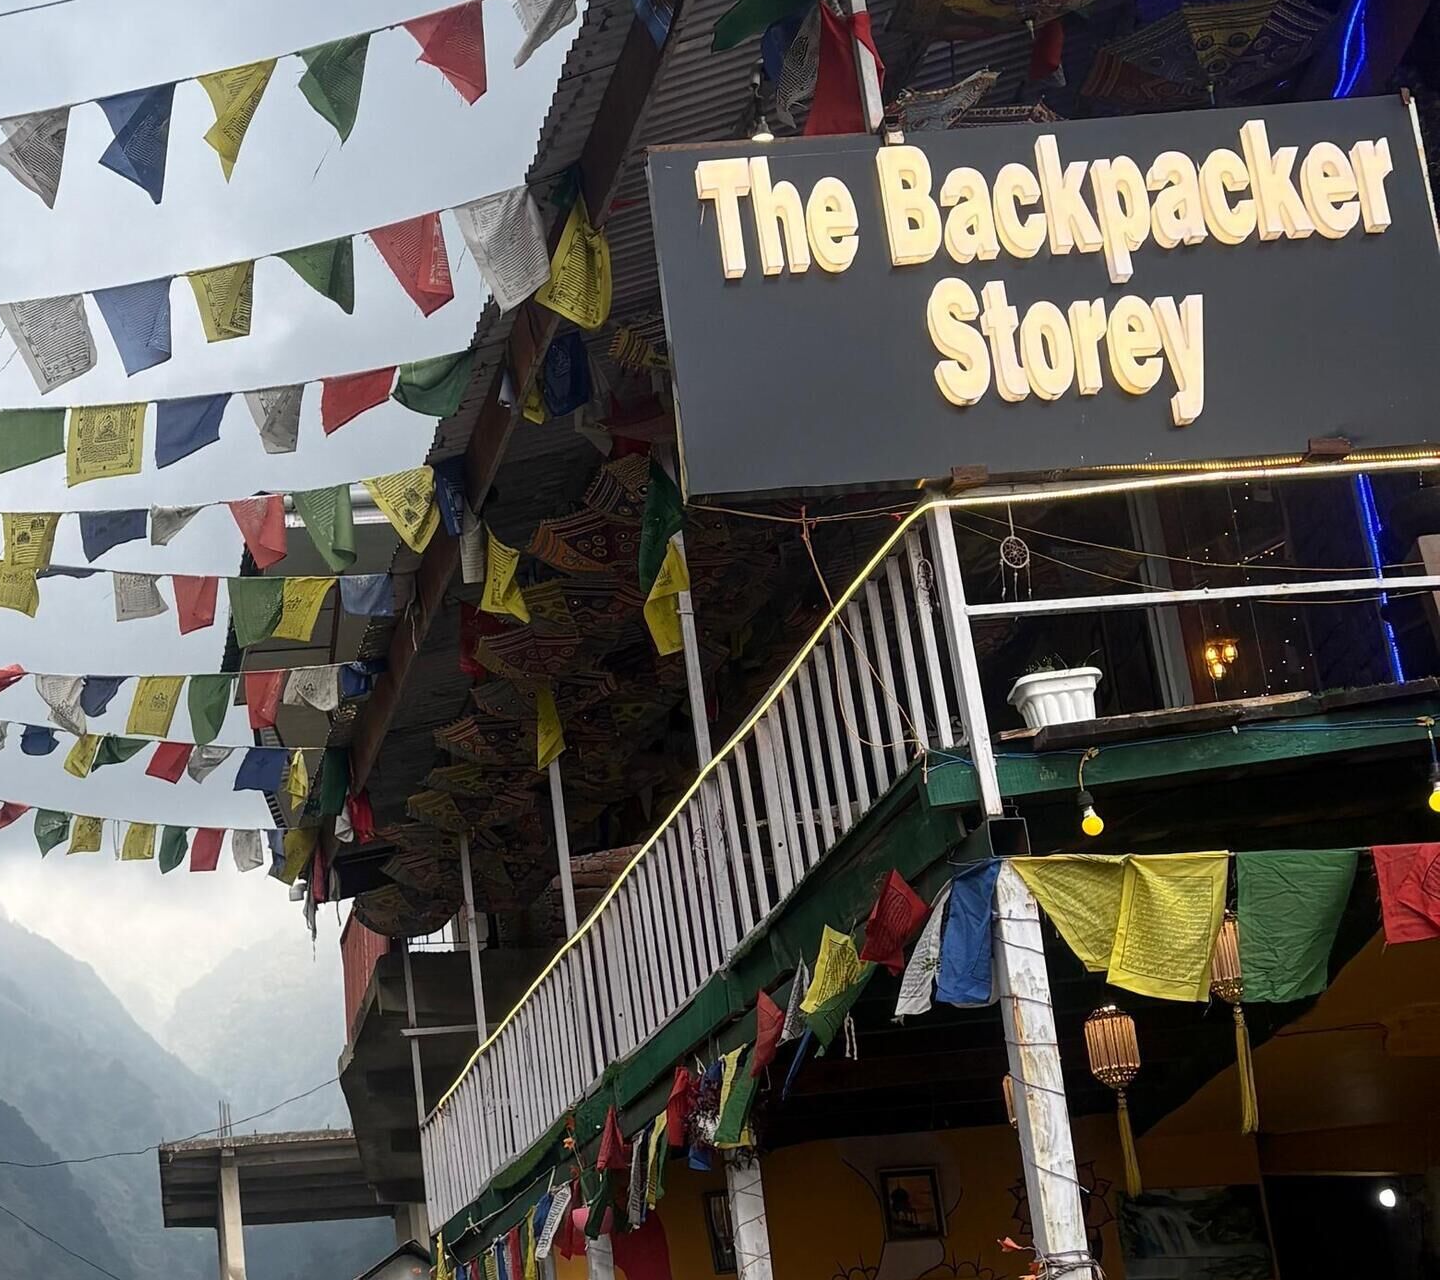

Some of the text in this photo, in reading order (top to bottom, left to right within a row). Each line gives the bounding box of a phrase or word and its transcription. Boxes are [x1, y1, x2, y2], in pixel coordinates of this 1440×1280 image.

[695, 156, 859, 279] The
[876, 119, 1394, 284] Backpacker
[926, 277, 1205, 426] Storey
